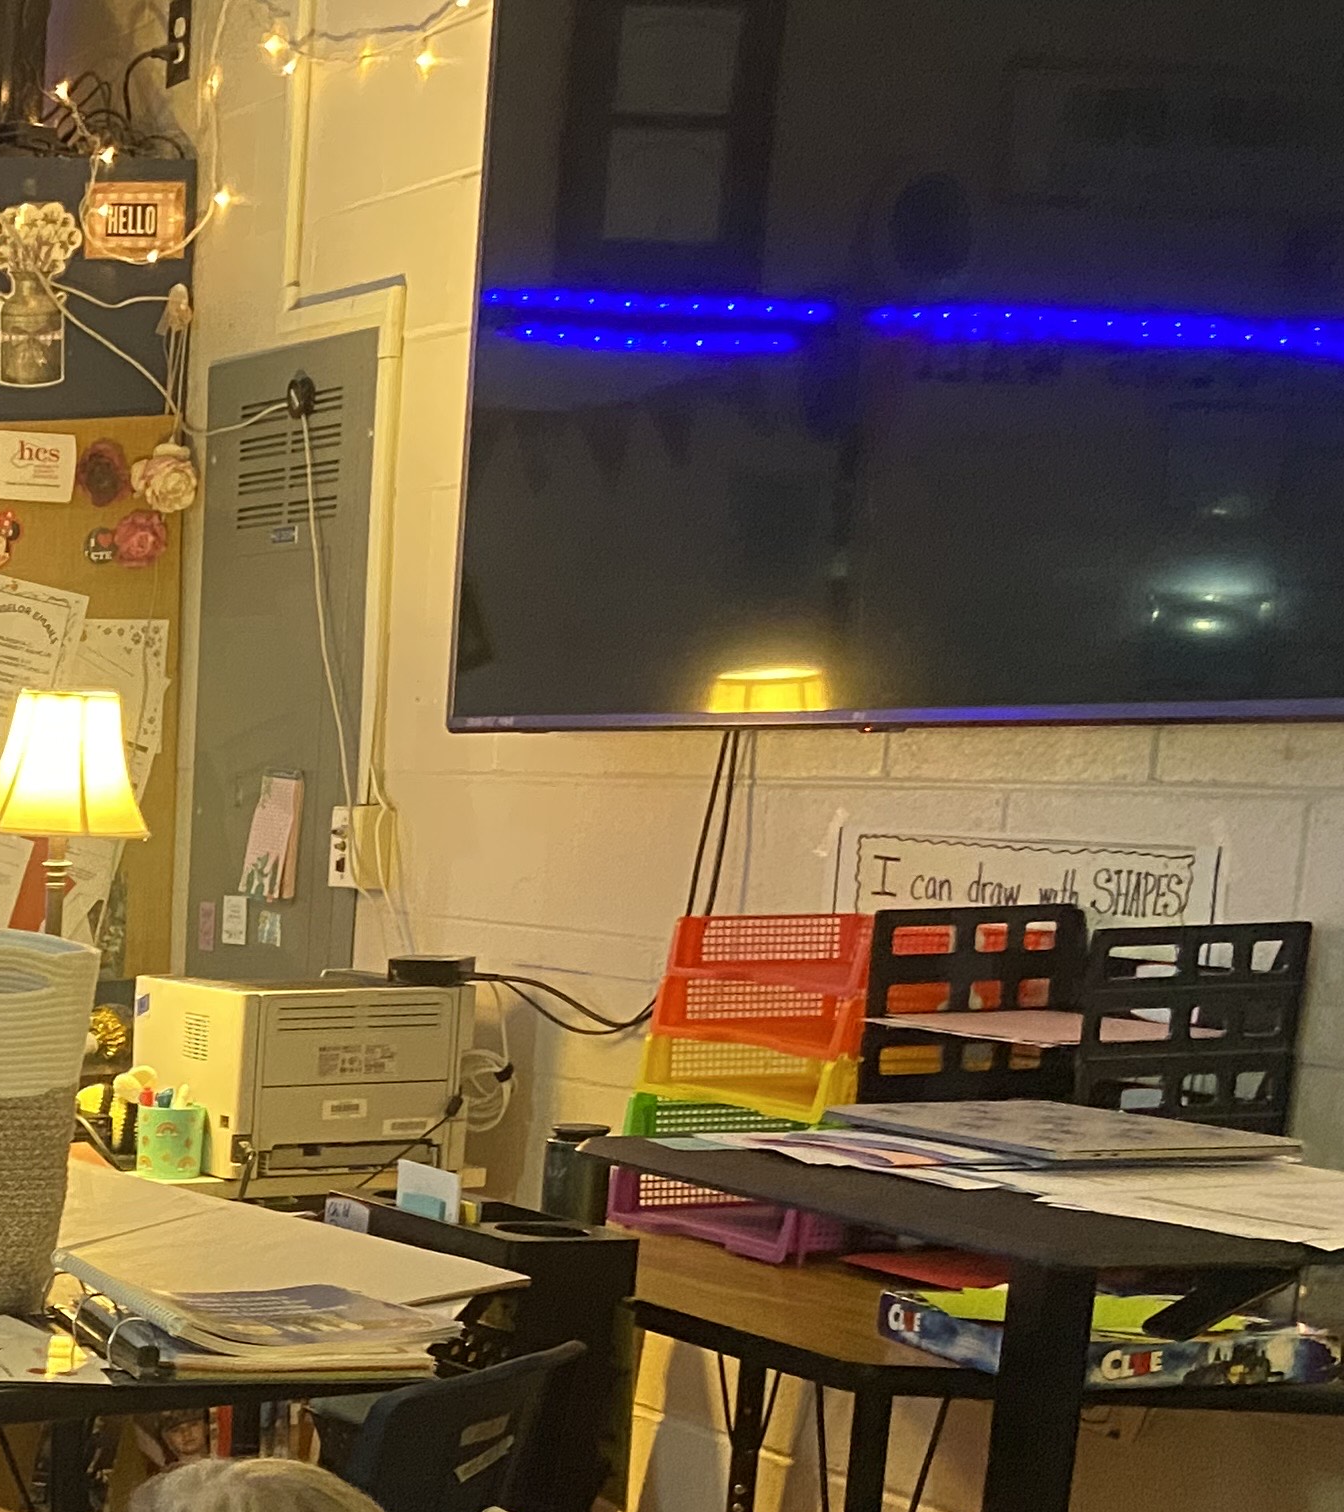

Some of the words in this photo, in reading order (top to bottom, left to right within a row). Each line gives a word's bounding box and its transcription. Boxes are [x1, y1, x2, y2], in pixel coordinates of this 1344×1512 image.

[107, 205, 156, 236] HELLO
[18, 440, 61, 463] hcs
[870, 854, 901, 897] I
[909, 873, 953, 902] can
[966, 861, 1022, 906] draw
[1089, 867, 1189, 919] SHAPES
